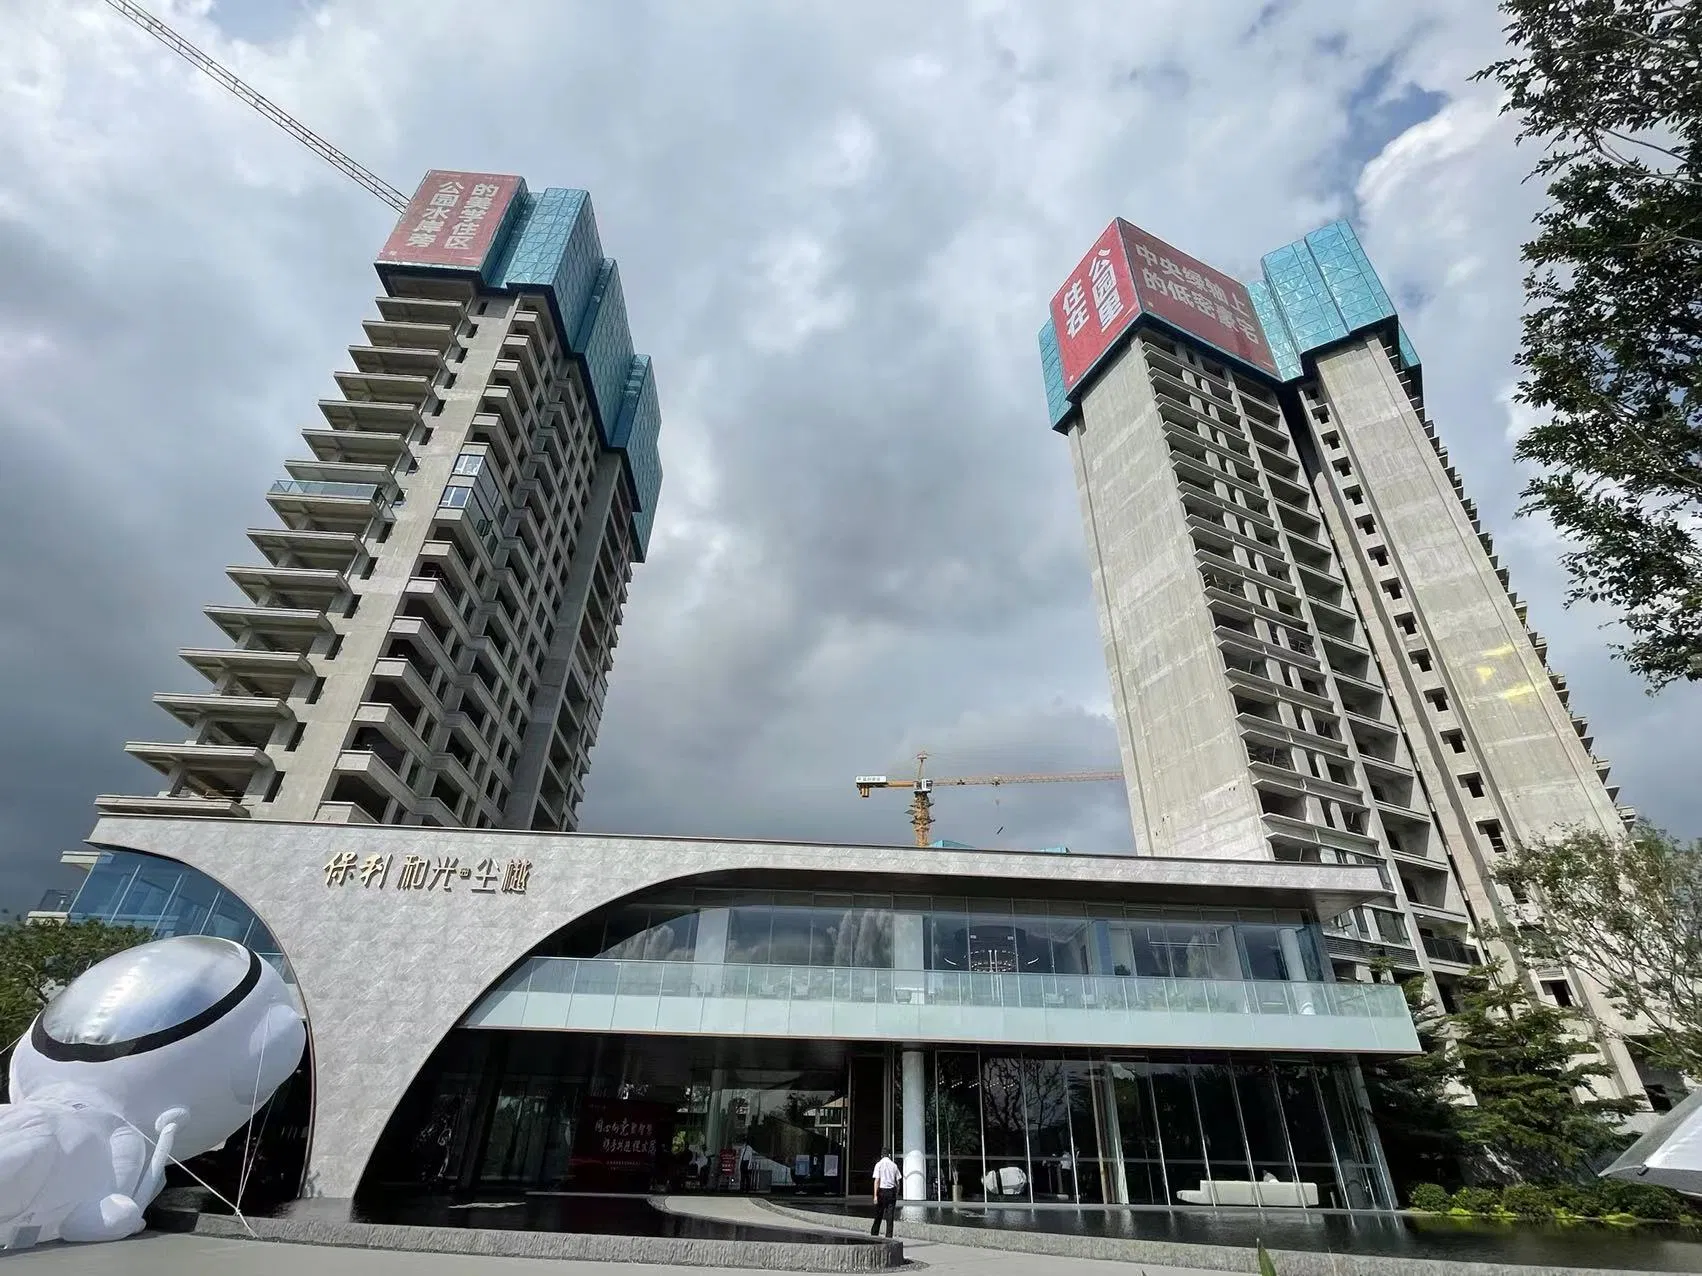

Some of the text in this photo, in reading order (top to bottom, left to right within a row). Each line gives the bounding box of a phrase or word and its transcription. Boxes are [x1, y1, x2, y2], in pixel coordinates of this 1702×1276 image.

[1062, 278, 1090, 339] 住在
[1088, 248, 1124, 332] 公园里
[1135, 243, 1250, 318] 中央绿轴上
